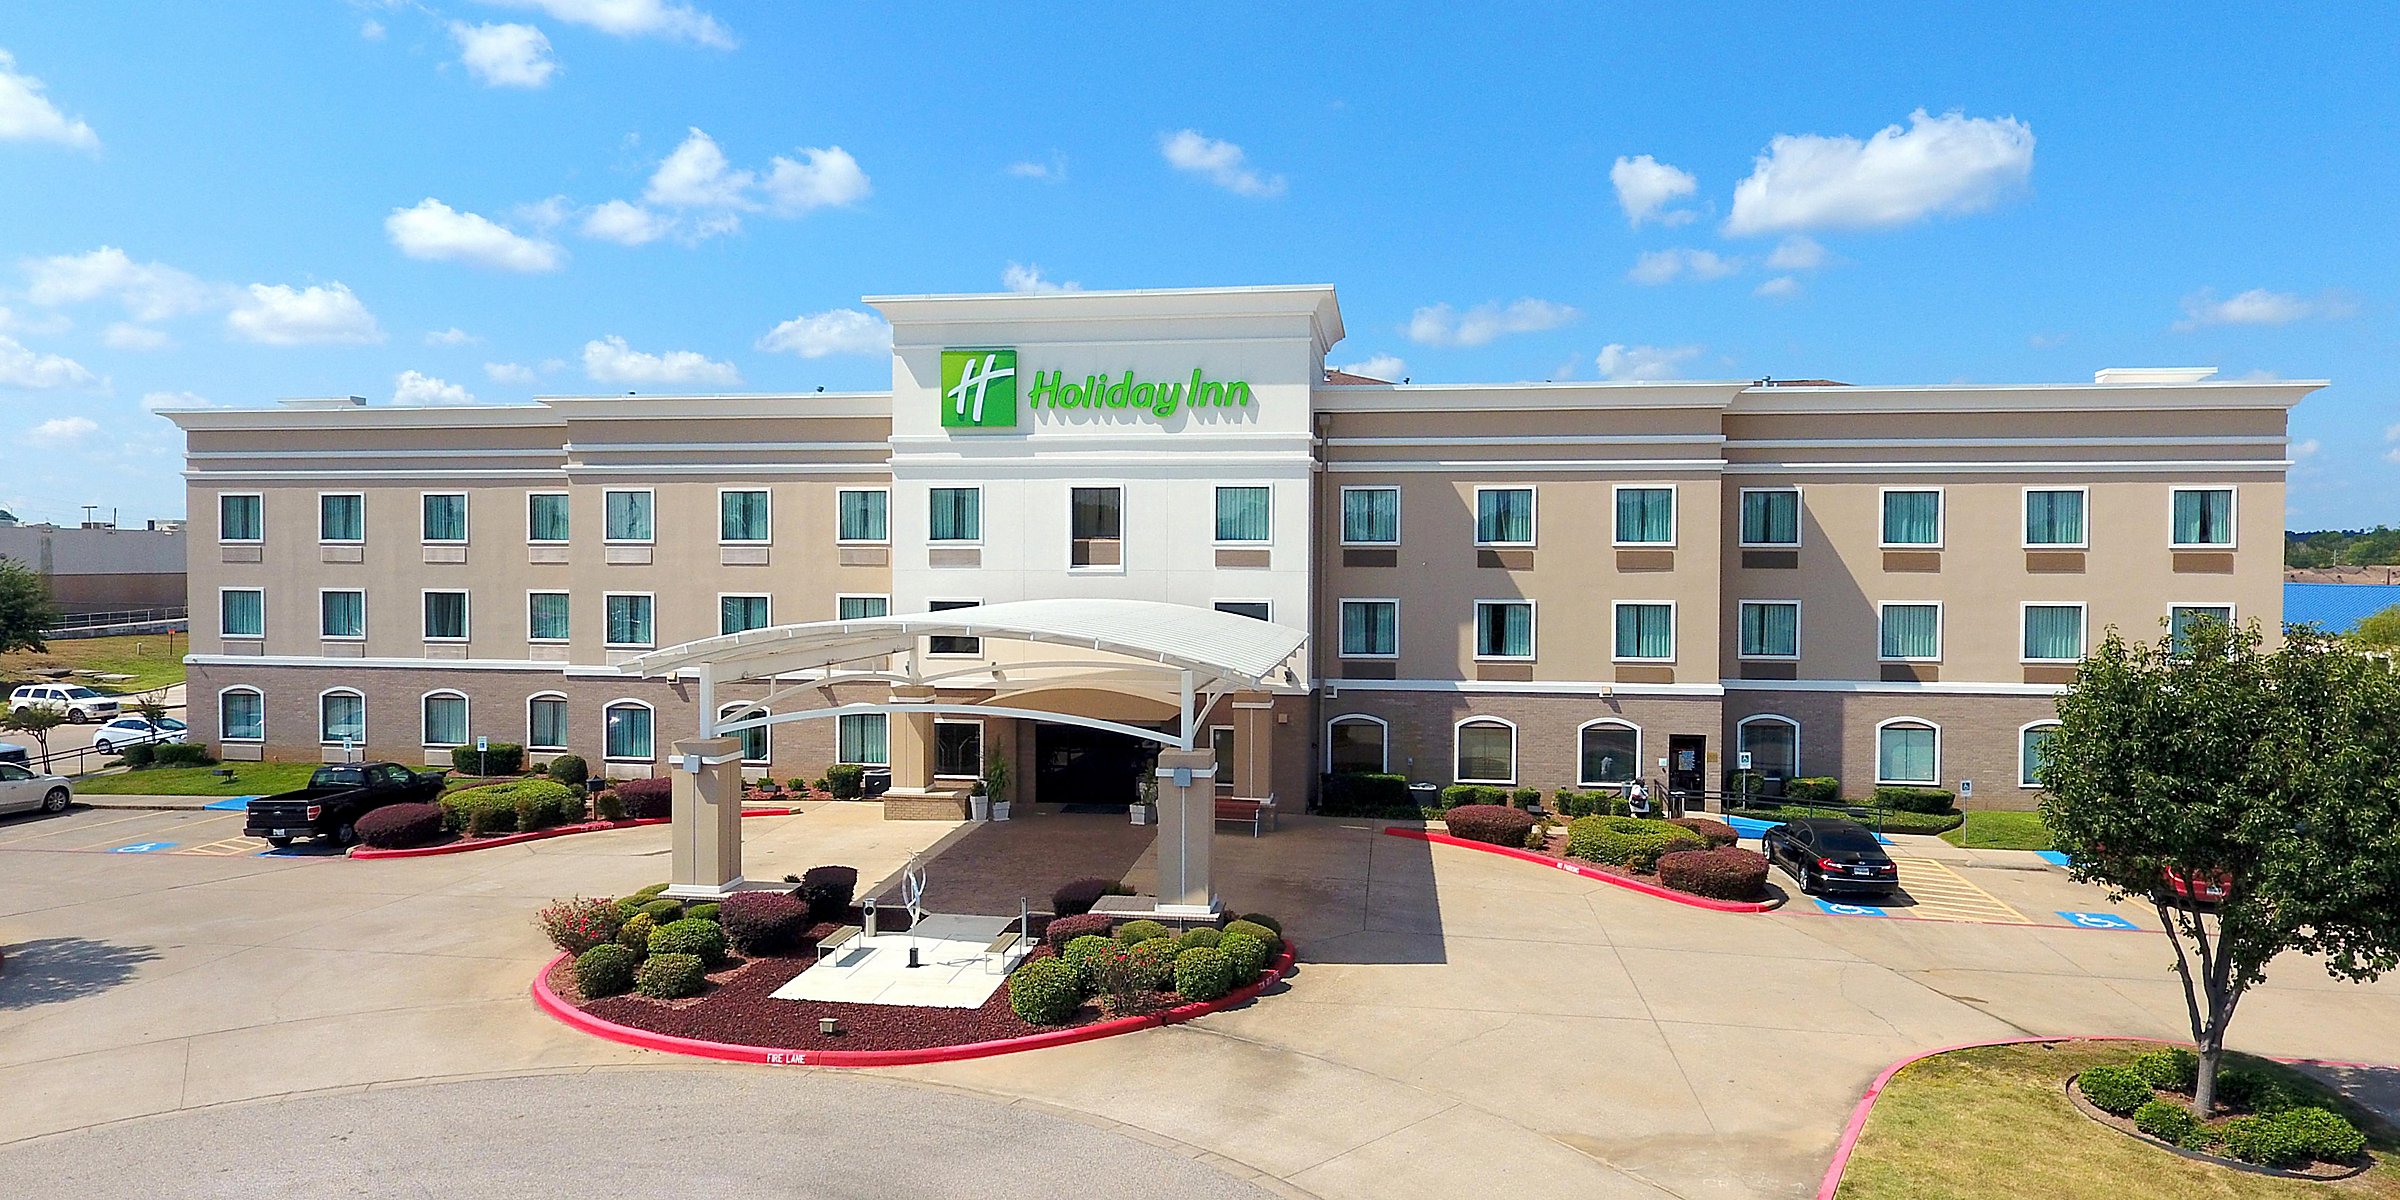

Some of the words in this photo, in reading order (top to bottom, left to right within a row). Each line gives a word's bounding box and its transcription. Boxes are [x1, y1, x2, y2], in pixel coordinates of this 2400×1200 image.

[948, 354, 1015, 422] H
[1028, 370, 1181, 418] Holiday
[1187, 368, 1250, 408] Inn
[766, 1053, 784, 1063] FIRE
[785, 1053, 806, 1064] LANE
